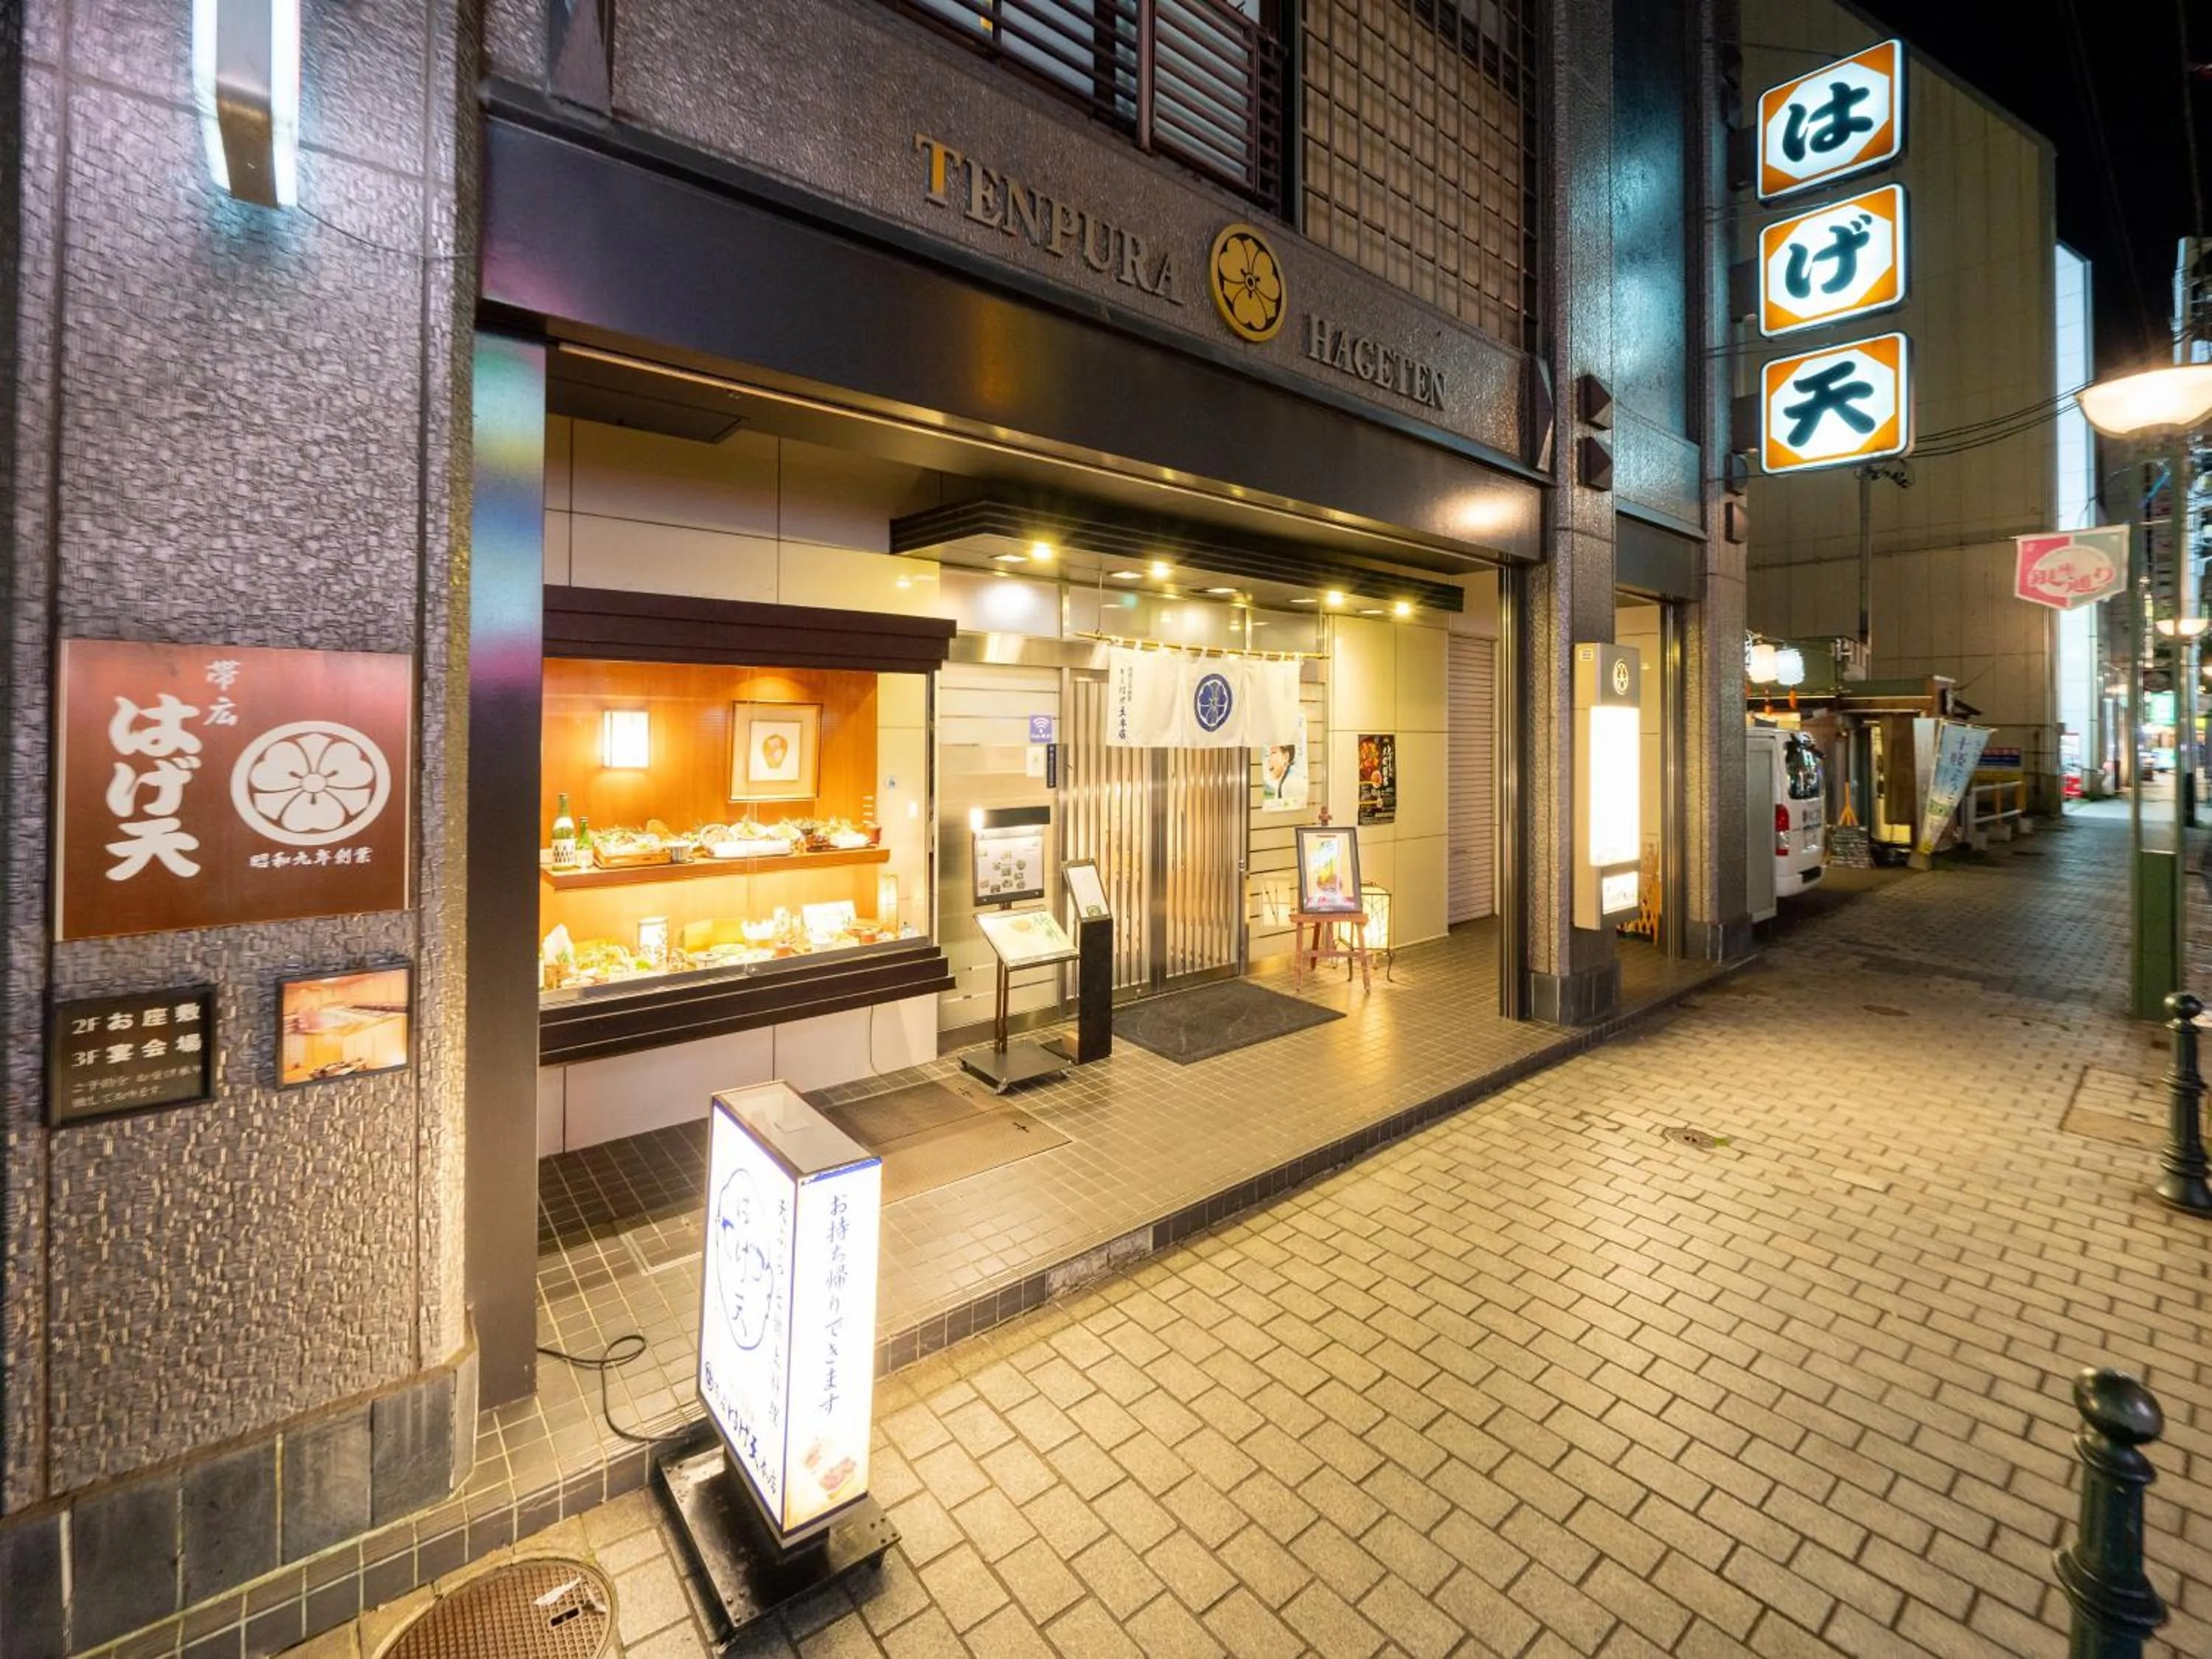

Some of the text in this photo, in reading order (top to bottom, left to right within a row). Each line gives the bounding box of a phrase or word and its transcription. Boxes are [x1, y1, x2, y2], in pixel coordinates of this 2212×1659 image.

[915, 133, 1183, 306] TENPURA
[1782, 81, 1874, 448] はげ天
[1306, 313, 1446, 411] HAGETEN
[202, 660, 241, 726] 帯広
[105, 693, 203, 880] はげ天
[72, 1017, 101, 1034] 2F
[72, 1050, 101, 1068] 3F
[818, 1193, 849, 1415] お持ち帰りできます
